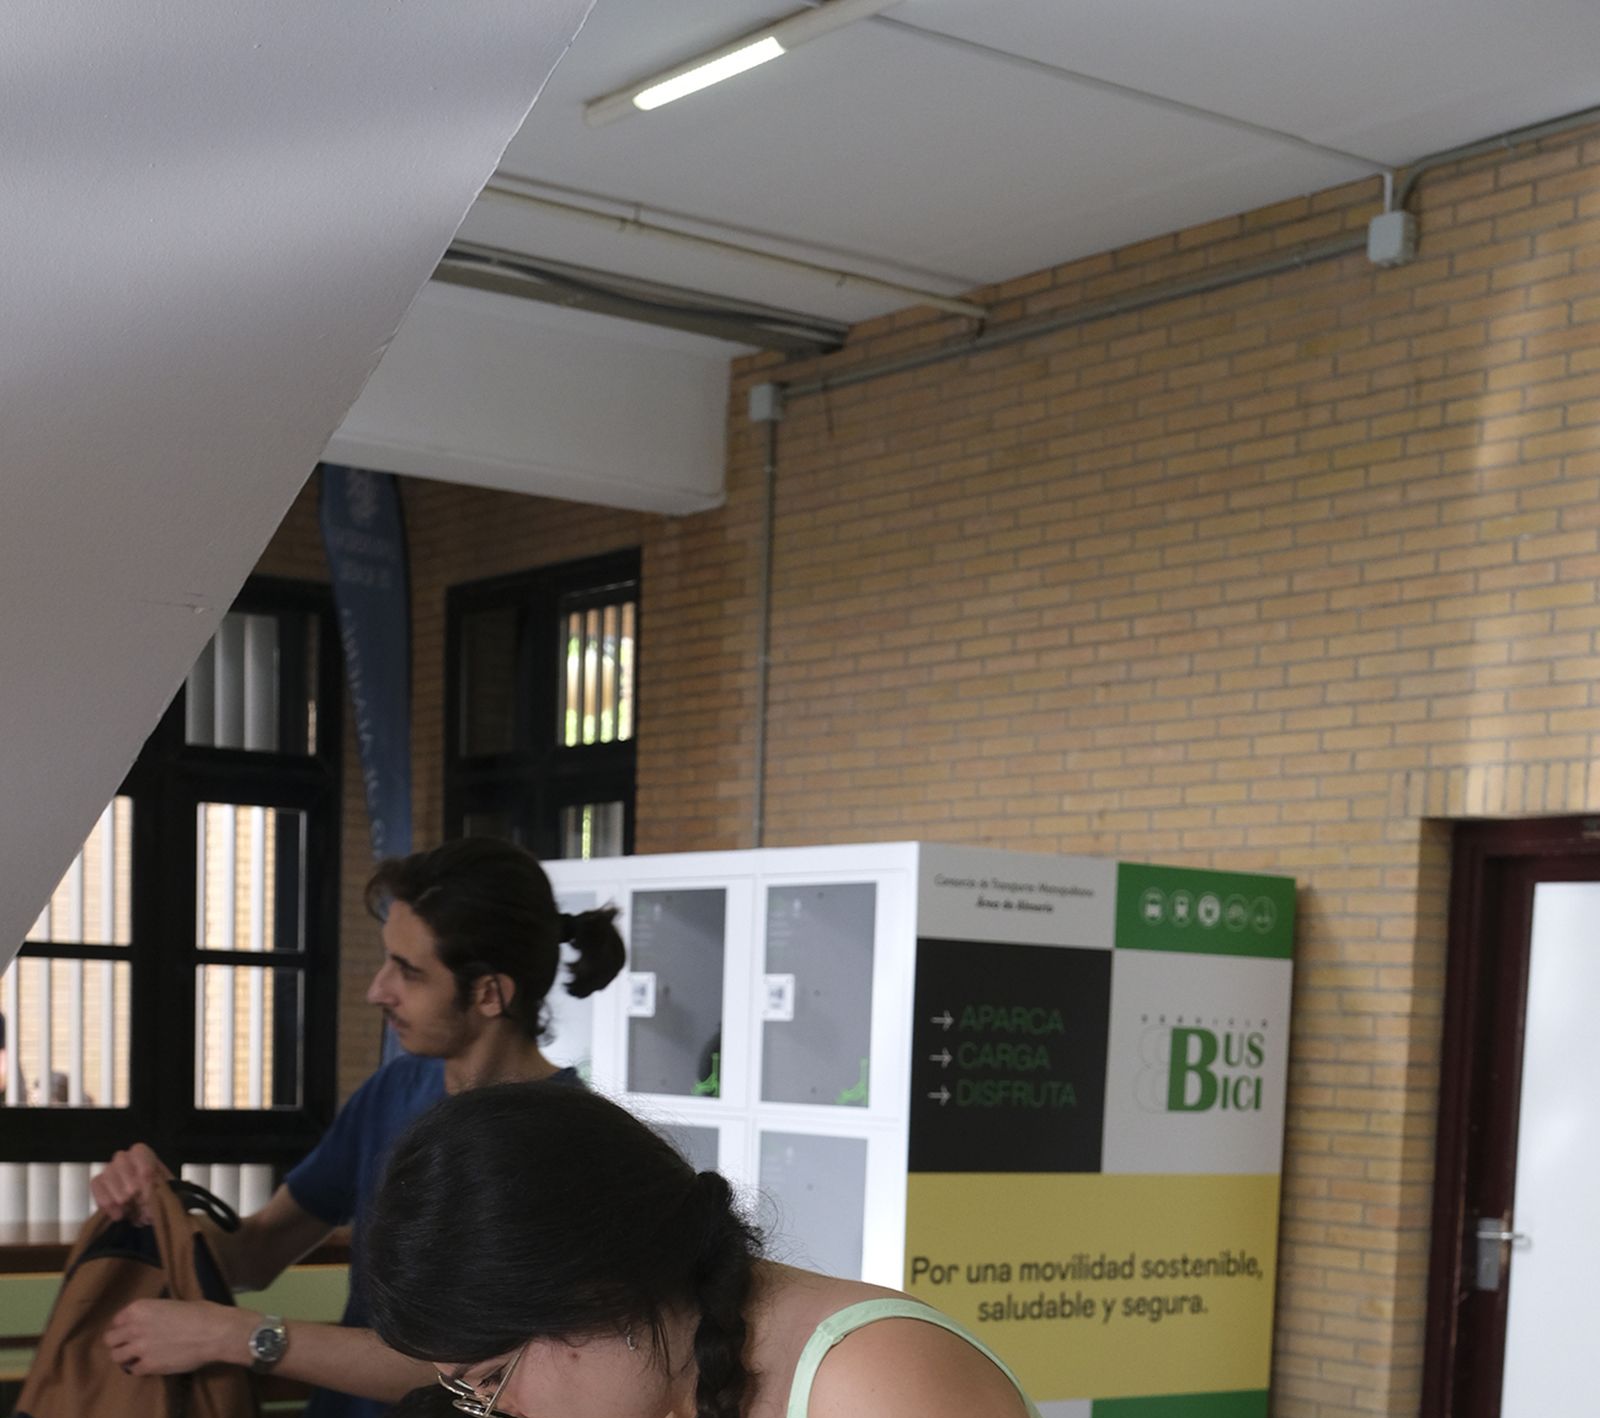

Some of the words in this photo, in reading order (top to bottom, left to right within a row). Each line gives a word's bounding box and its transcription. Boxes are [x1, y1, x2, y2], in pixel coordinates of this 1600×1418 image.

[958, 1004, 1065, 1034] APARCA
[957, 1042, 1052, 1072] CARGA
[955, 1078, 1079, 1109] DISFRUTA
[911, 1256, 958, 1285] Por
[966, 1261, 1012, 1284] una
[1019, 1253, 1136, 1282] movilidad
[1140, 1250, 1264, 1280] sostenible,
[977, 1292, 1097, 1323] saludable
[1103, 1297, 1116, 1324] y
[1121, 1293, 1209, 1322] segura.
